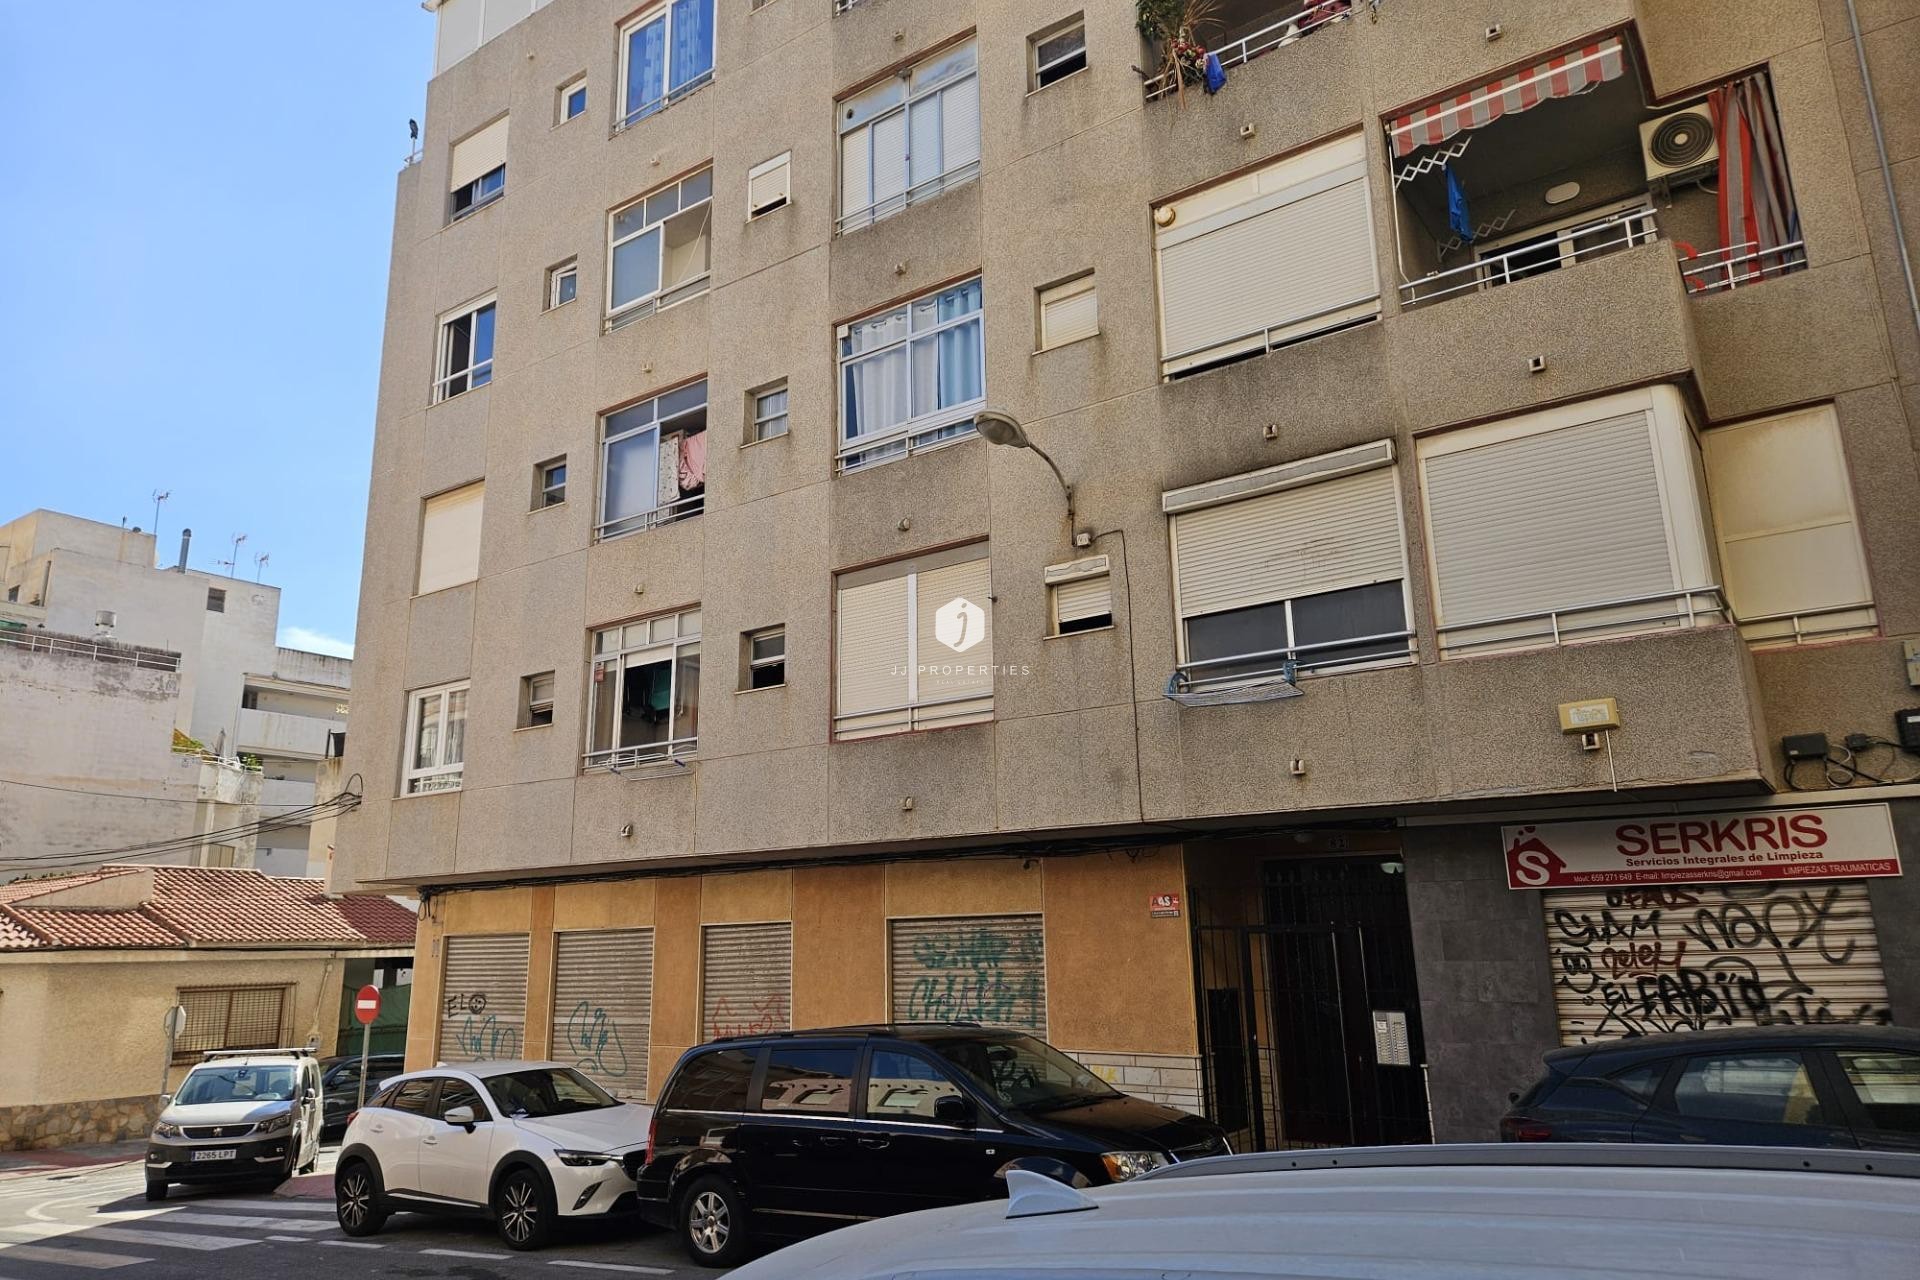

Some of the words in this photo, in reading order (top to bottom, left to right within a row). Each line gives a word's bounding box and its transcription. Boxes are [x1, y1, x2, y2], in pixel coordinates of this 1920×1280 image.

[1616, 814, 1828, 857] SERKRIS
[1626, 856, 1680, 867] Servicios
[1684, 853, 1745, 867] Integrales
[1749, 853, 1764, 862] de
[1767, 851, 1825, 863] Limpieza
[1783, 864, 1828, 875] LIMPIEZAS
[1605, 873, 1618, 881] 271
[196, 1151, 217, 1160] 2265
[218, 1150, 235, 1159] LPT
